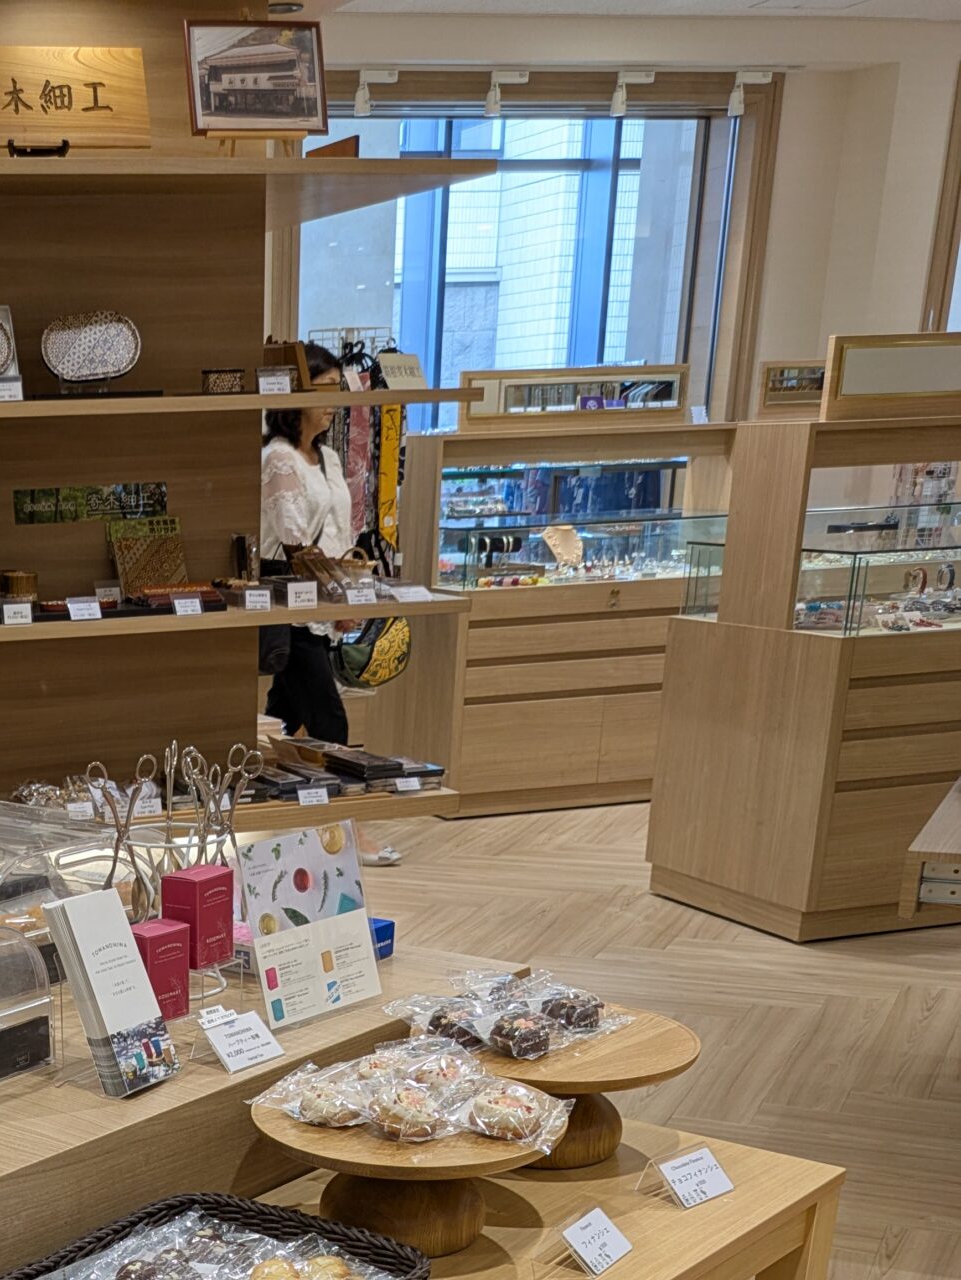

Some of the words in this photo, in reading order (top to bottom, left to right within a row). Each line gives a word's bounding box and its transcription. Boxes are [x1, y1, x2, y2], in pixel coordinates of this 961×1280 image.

[88, 491, 154, 510] 寄木細工
[226, 1048, 245, 1059] ¥2,000
[671, 1163, 719, 1186] チョコフィナンシェ
[581, 1227, 610, 1249] フィナンシェ
